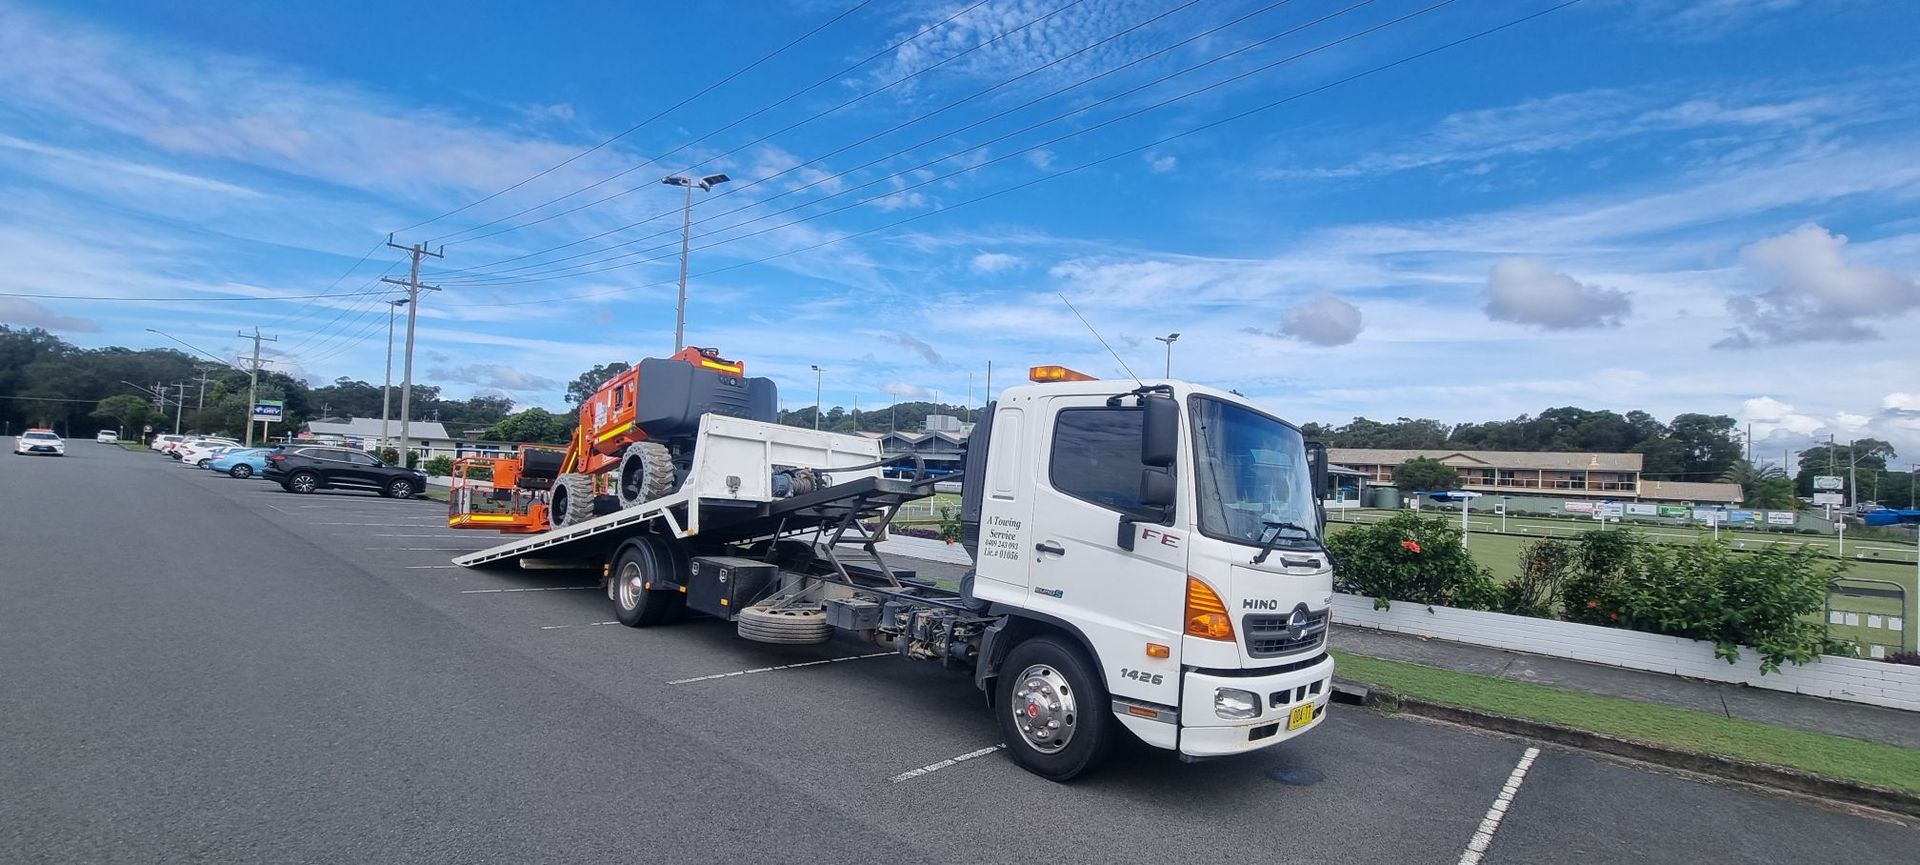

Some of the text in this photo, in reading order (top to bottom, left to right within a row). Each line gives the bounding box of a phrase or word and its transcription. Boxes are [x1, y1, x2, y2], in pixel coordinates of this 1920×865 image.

[987, 516, 1022, 530] A Towing
[989, 529, 1016, 541] Service
[1142, 528, 1181, 548] FE
[1243, 599, 1277, 610] HINO
[1121, 668, 1163, 685] 1426
